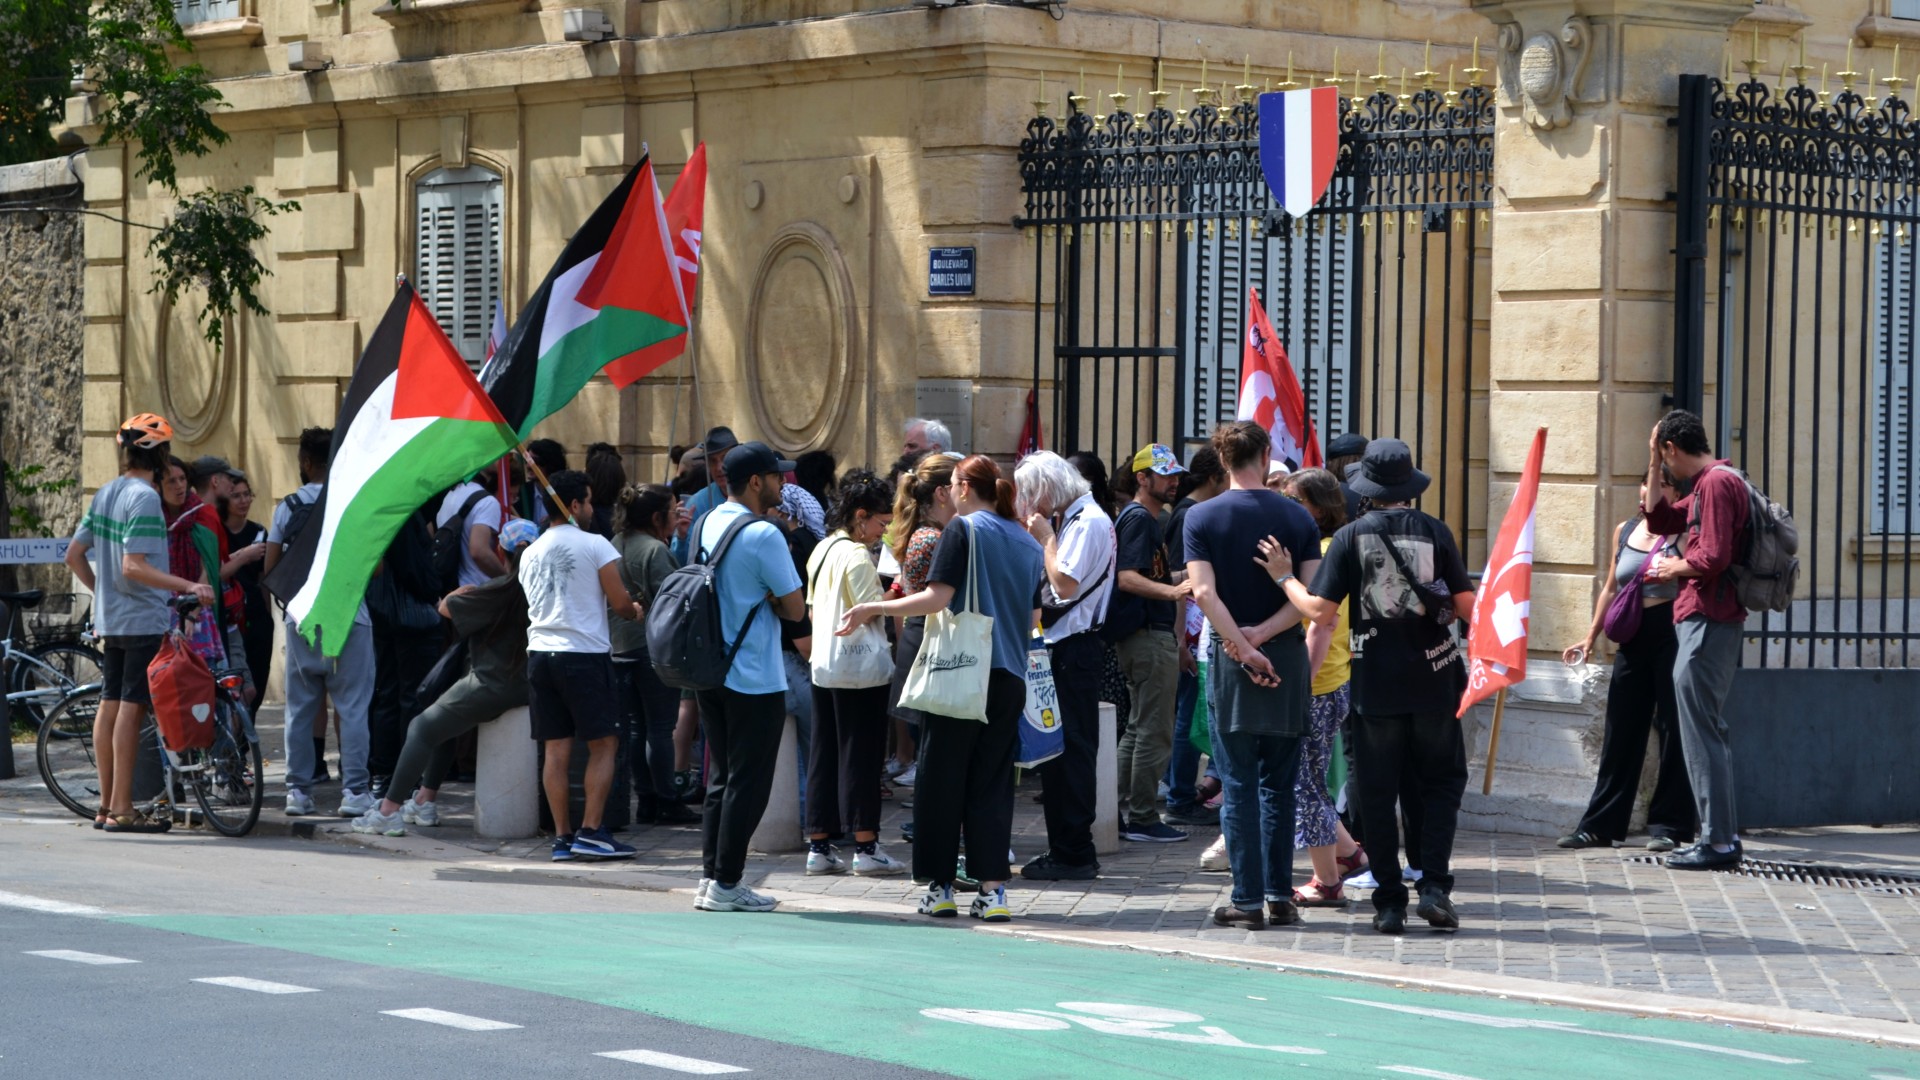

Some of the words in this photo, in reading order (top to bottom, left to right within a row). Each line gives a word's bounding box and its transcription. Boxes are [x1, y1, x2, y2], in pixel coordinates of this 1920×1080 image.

[933, 259, 969, 269] BOULEVARD
[930, 273, 954, 286] CHARLES
[837, 643, 873, 656] LYMPA
[1432, 656, 1449, 673] Love
[1027, 669, 1053, 682] France
